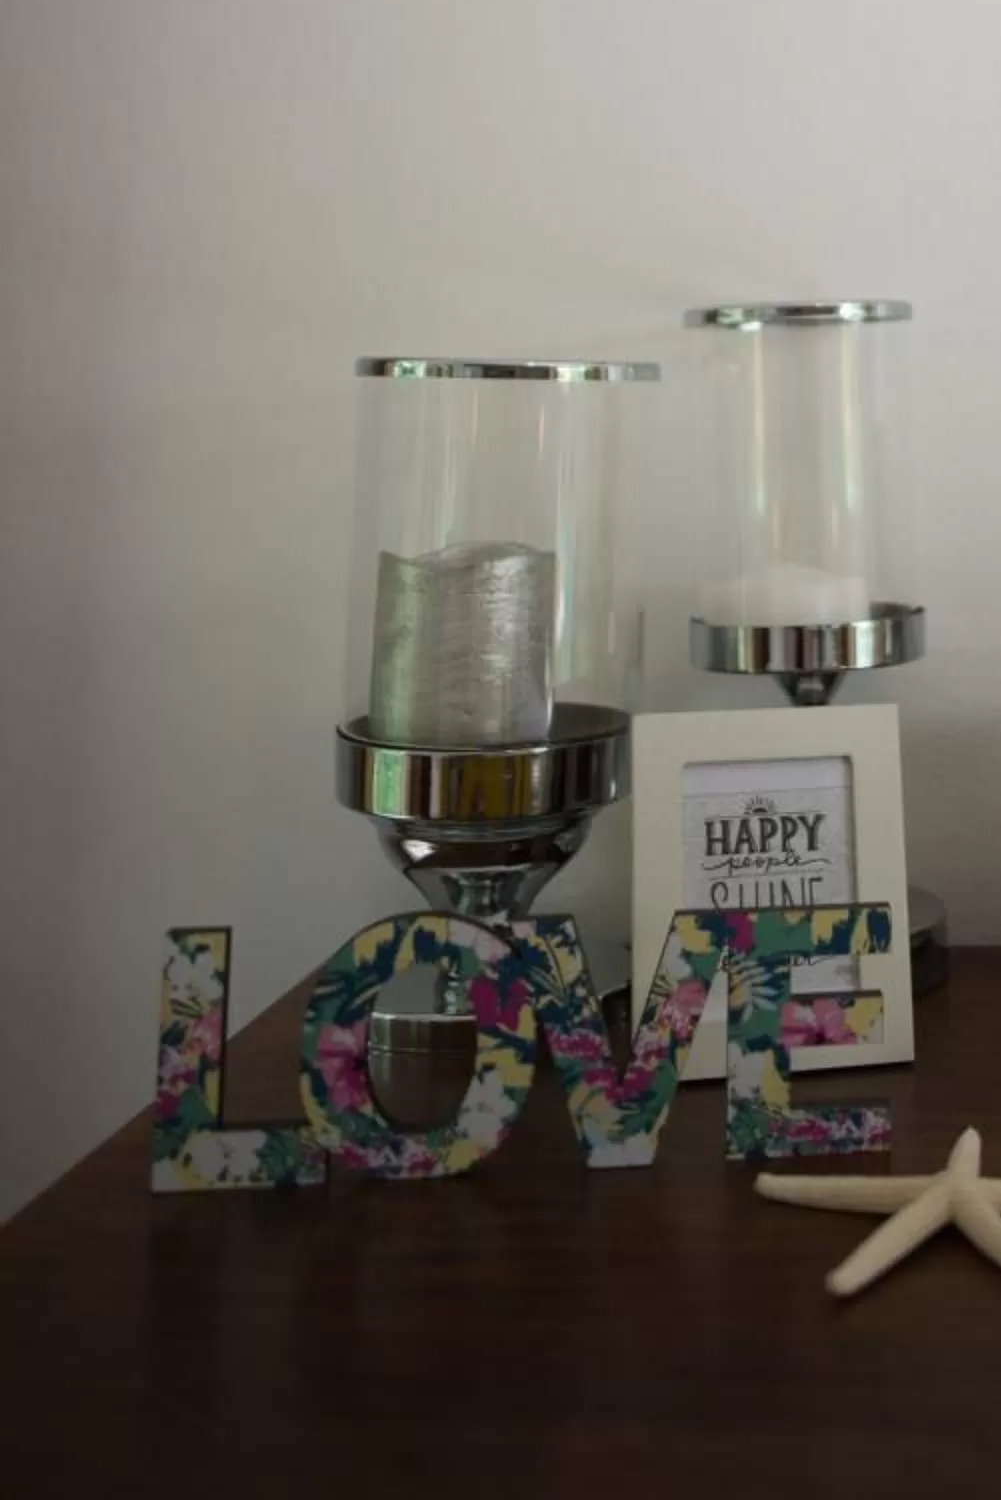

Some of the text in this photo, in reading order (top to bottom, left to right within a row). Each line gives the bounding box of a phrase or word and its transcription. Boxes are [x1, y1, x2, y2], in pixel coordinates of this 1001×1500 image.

[703, 814, 826, 856] HAPPY
[703, 848, 830, 876] people
[150, 901, 892, 1192] LOVE
